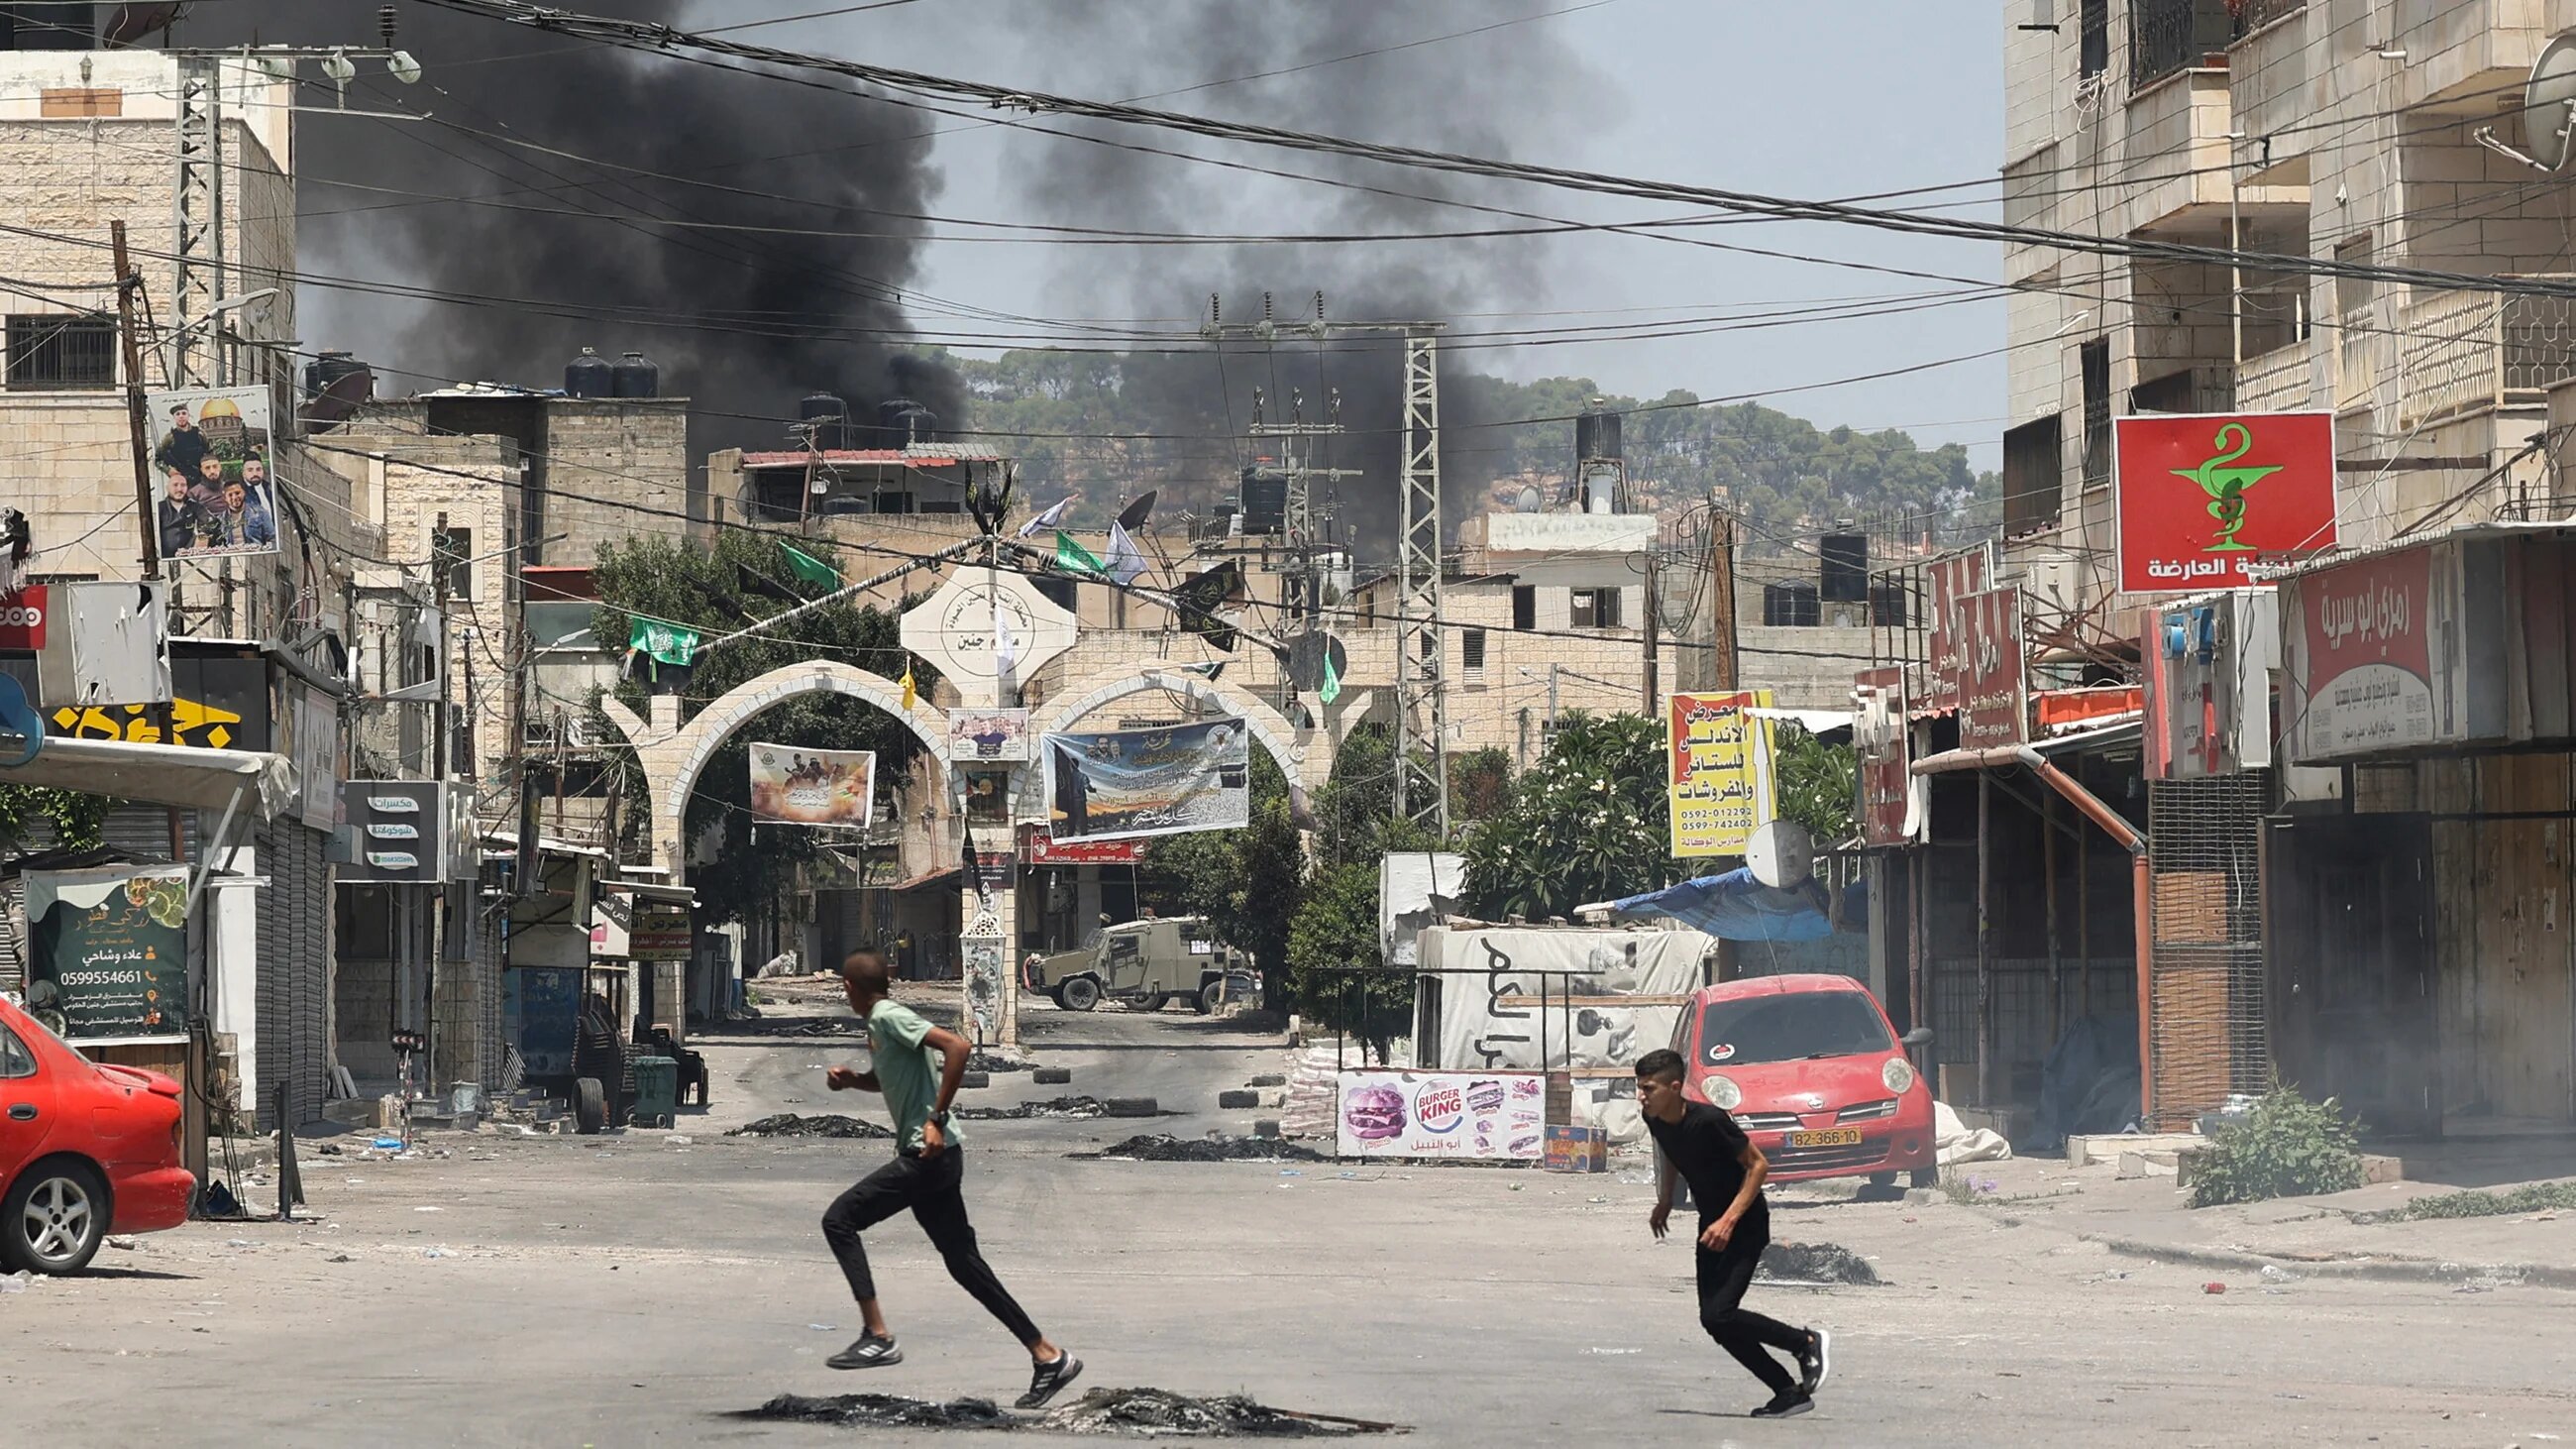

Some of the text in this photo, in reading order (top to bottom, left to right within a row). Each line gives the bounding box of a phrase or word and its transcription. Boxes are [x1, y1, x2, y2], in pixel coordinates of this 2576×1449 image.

[2148, 558, 2226, 581] العارضة
[957, 632, 986, 651] جنين
[1685, 701, 1739, 725] معرض
[1685, 753, 1745, 776] للستائر
[1678, 780, 1754, 802] والمفروشات
[374, 798, 413, 809] مكسرات
[1680, 808, 1753, 820] 0592-012292
[1681, 819, 1753, 832] 0599-742402
[1680, 836, 1716, 848] الوكالة
[81, 948, 143, 967] علاء وشاحي
[60, 970, 142, 986] 0599554661
[1419, 1088, 1459, 1107] BURGER
[1420, 1098, 1462, 1122] KING
